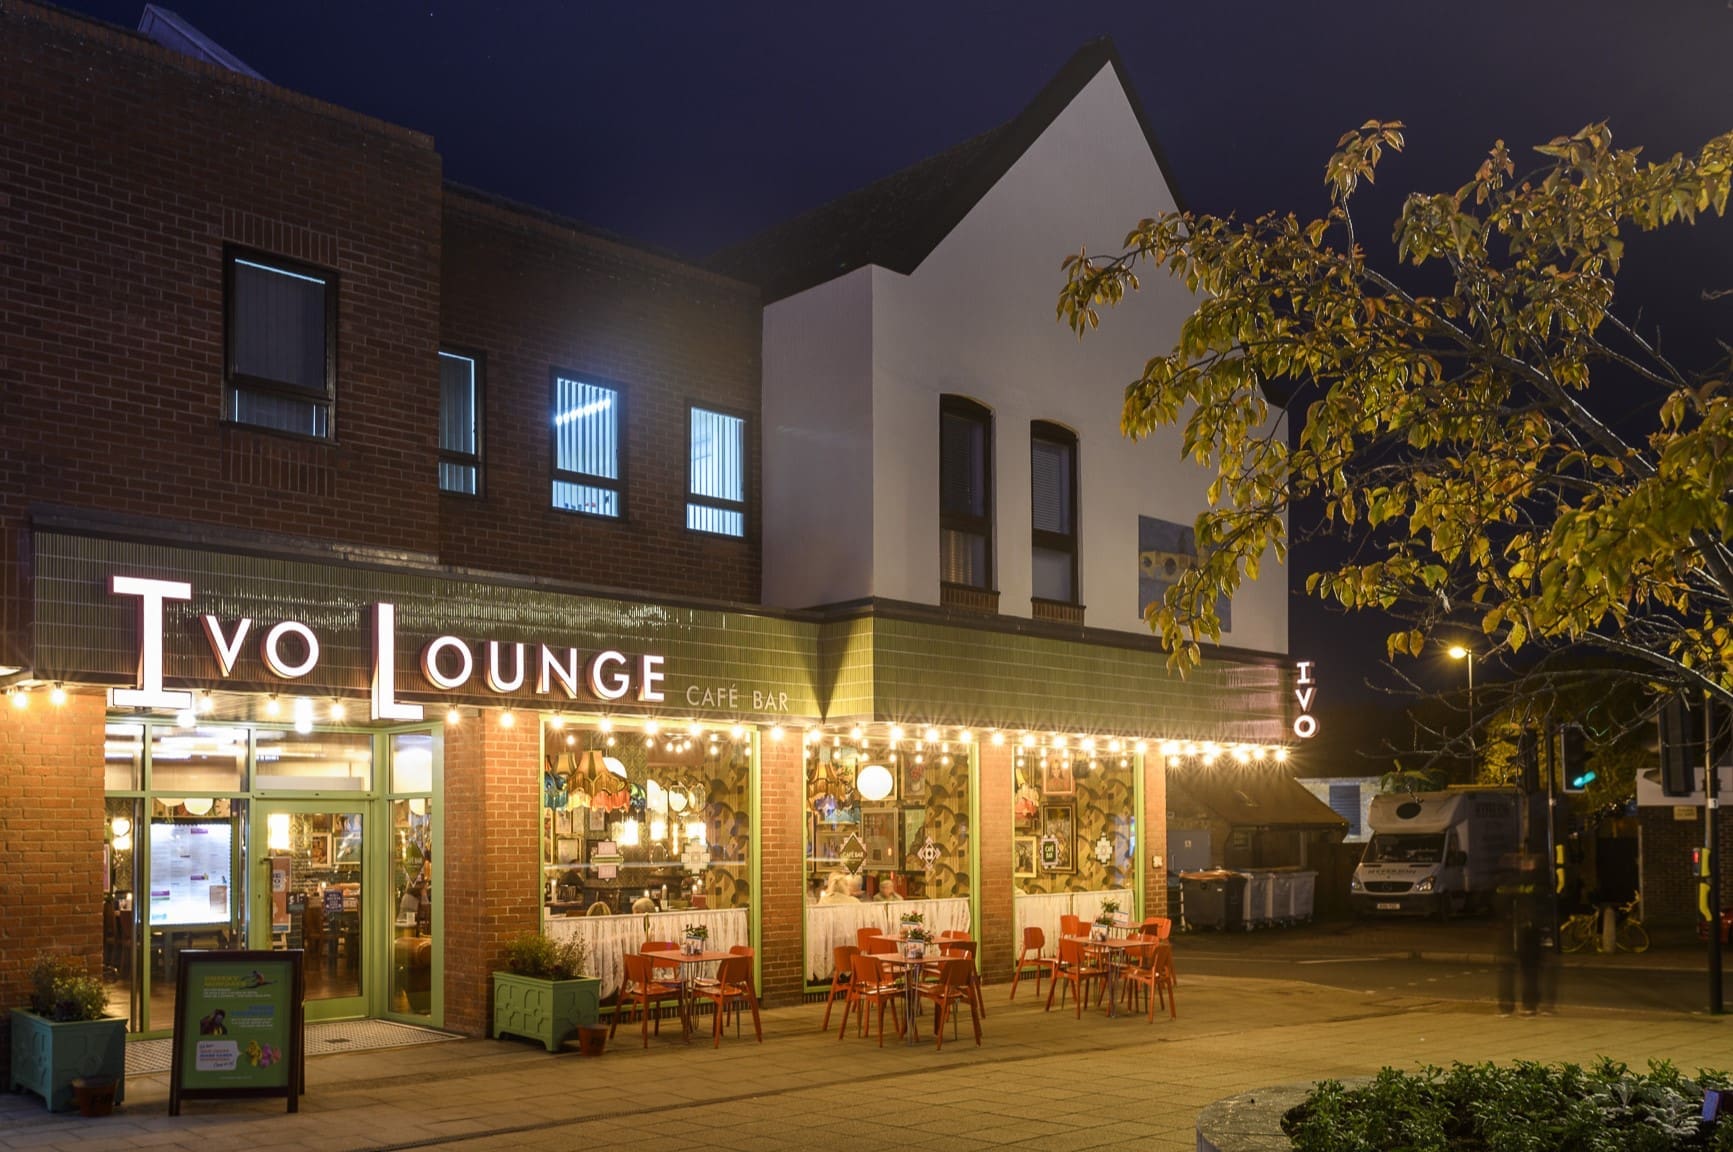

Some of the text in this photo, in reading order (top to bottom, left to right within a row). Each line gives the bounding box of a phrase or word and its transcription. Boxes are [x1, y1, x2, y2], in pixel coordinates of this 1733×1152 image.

[109, 575, 665, 720] IVO LOUNGE
[686, 683, 788, 712] CAFÉ BAR
[1294, 661, 1320, 738] IVO
